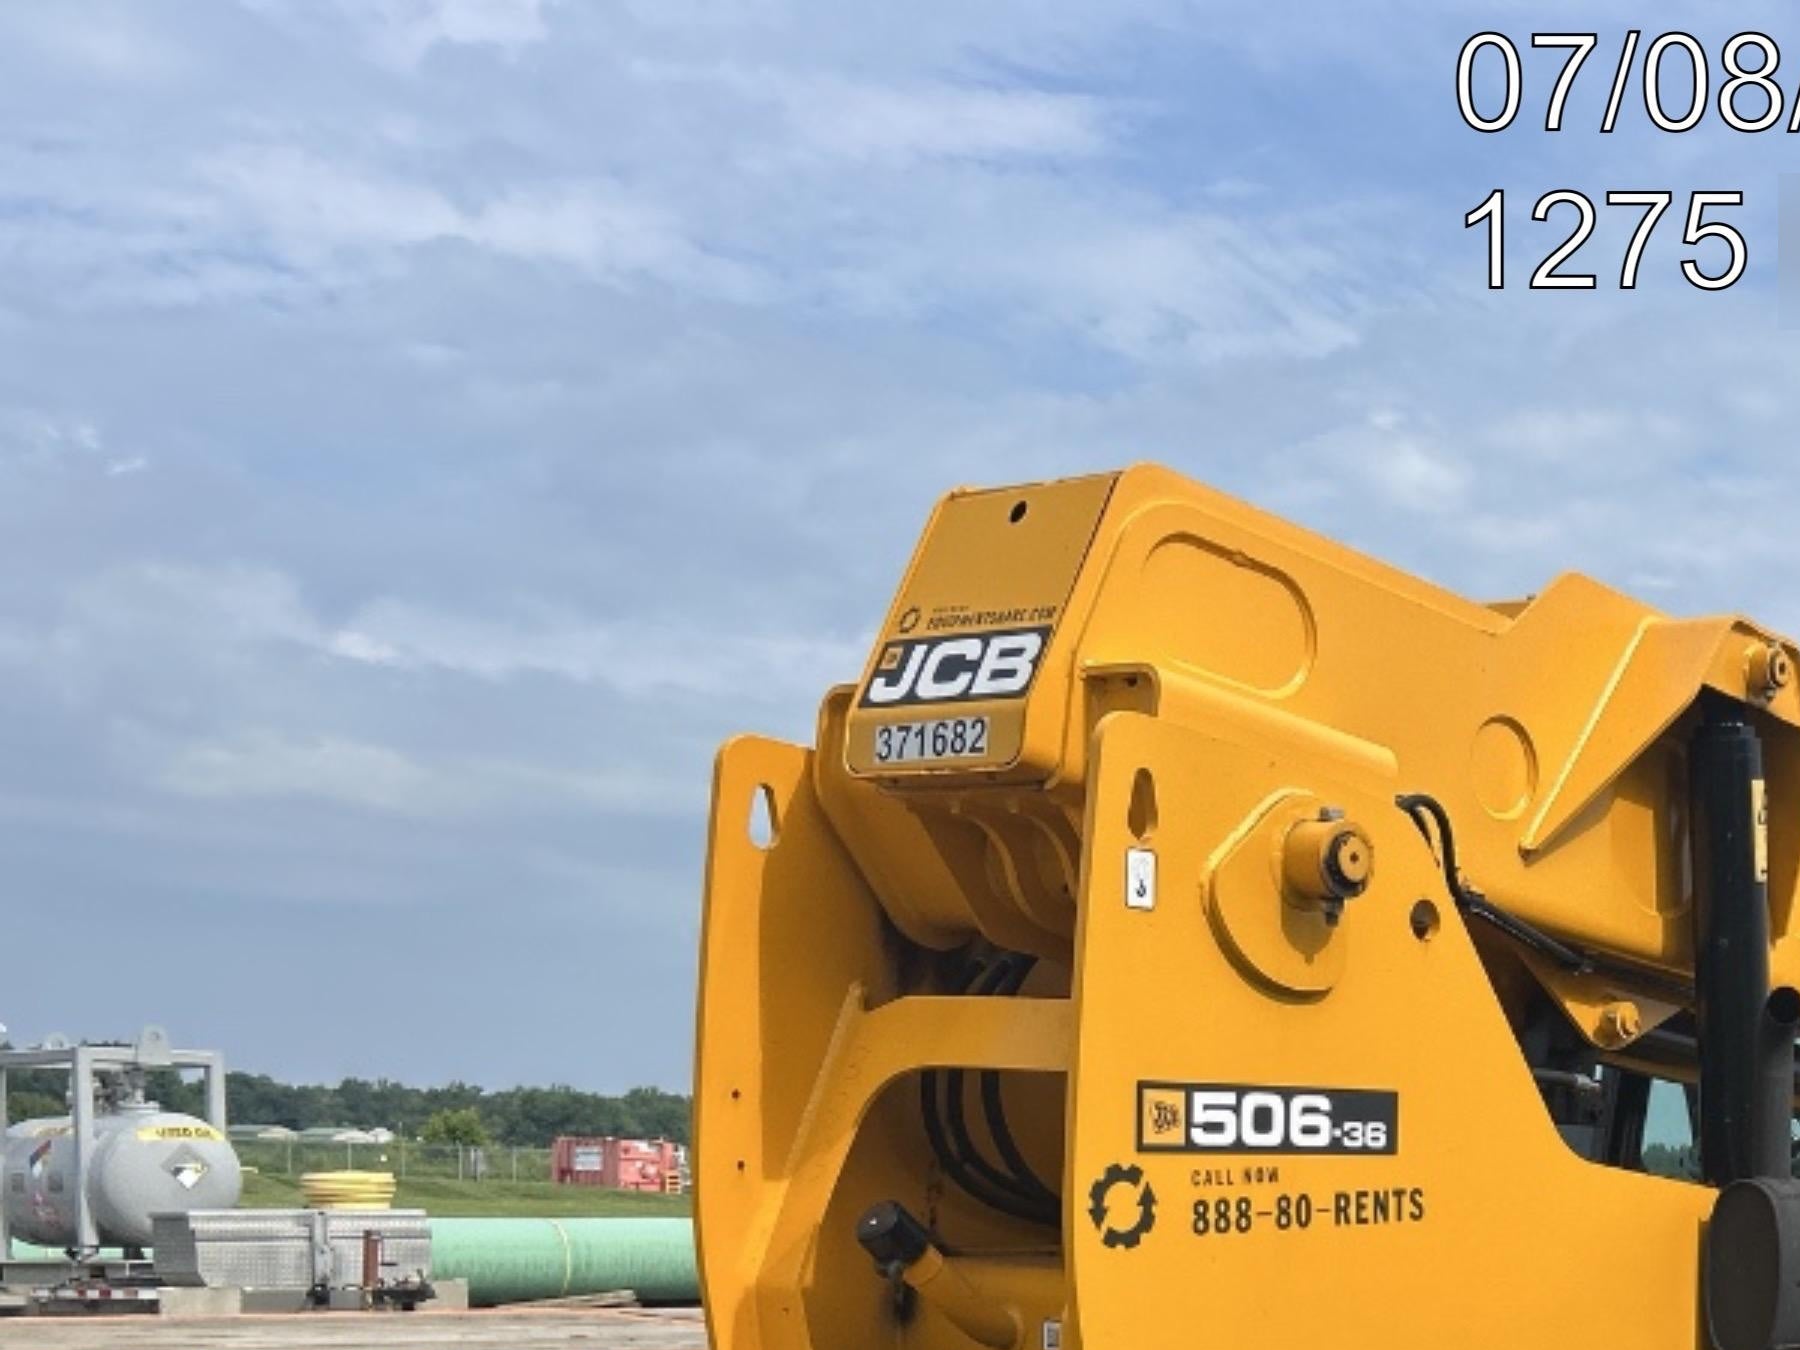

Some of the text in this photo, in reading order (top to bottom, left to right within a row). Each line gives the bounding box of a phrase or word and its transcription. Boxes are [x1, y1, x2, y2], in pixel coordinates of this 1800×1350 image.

[868, 632, 1042, 703] JCB
[876, 718, 987, 763] 371682
[1190, 1090, 1388, 1148] 506-36
[1191, 1166, 1280, 1187] CALL NOW
[1191, 1187, 1425, 1237] 888-80-RENTS
